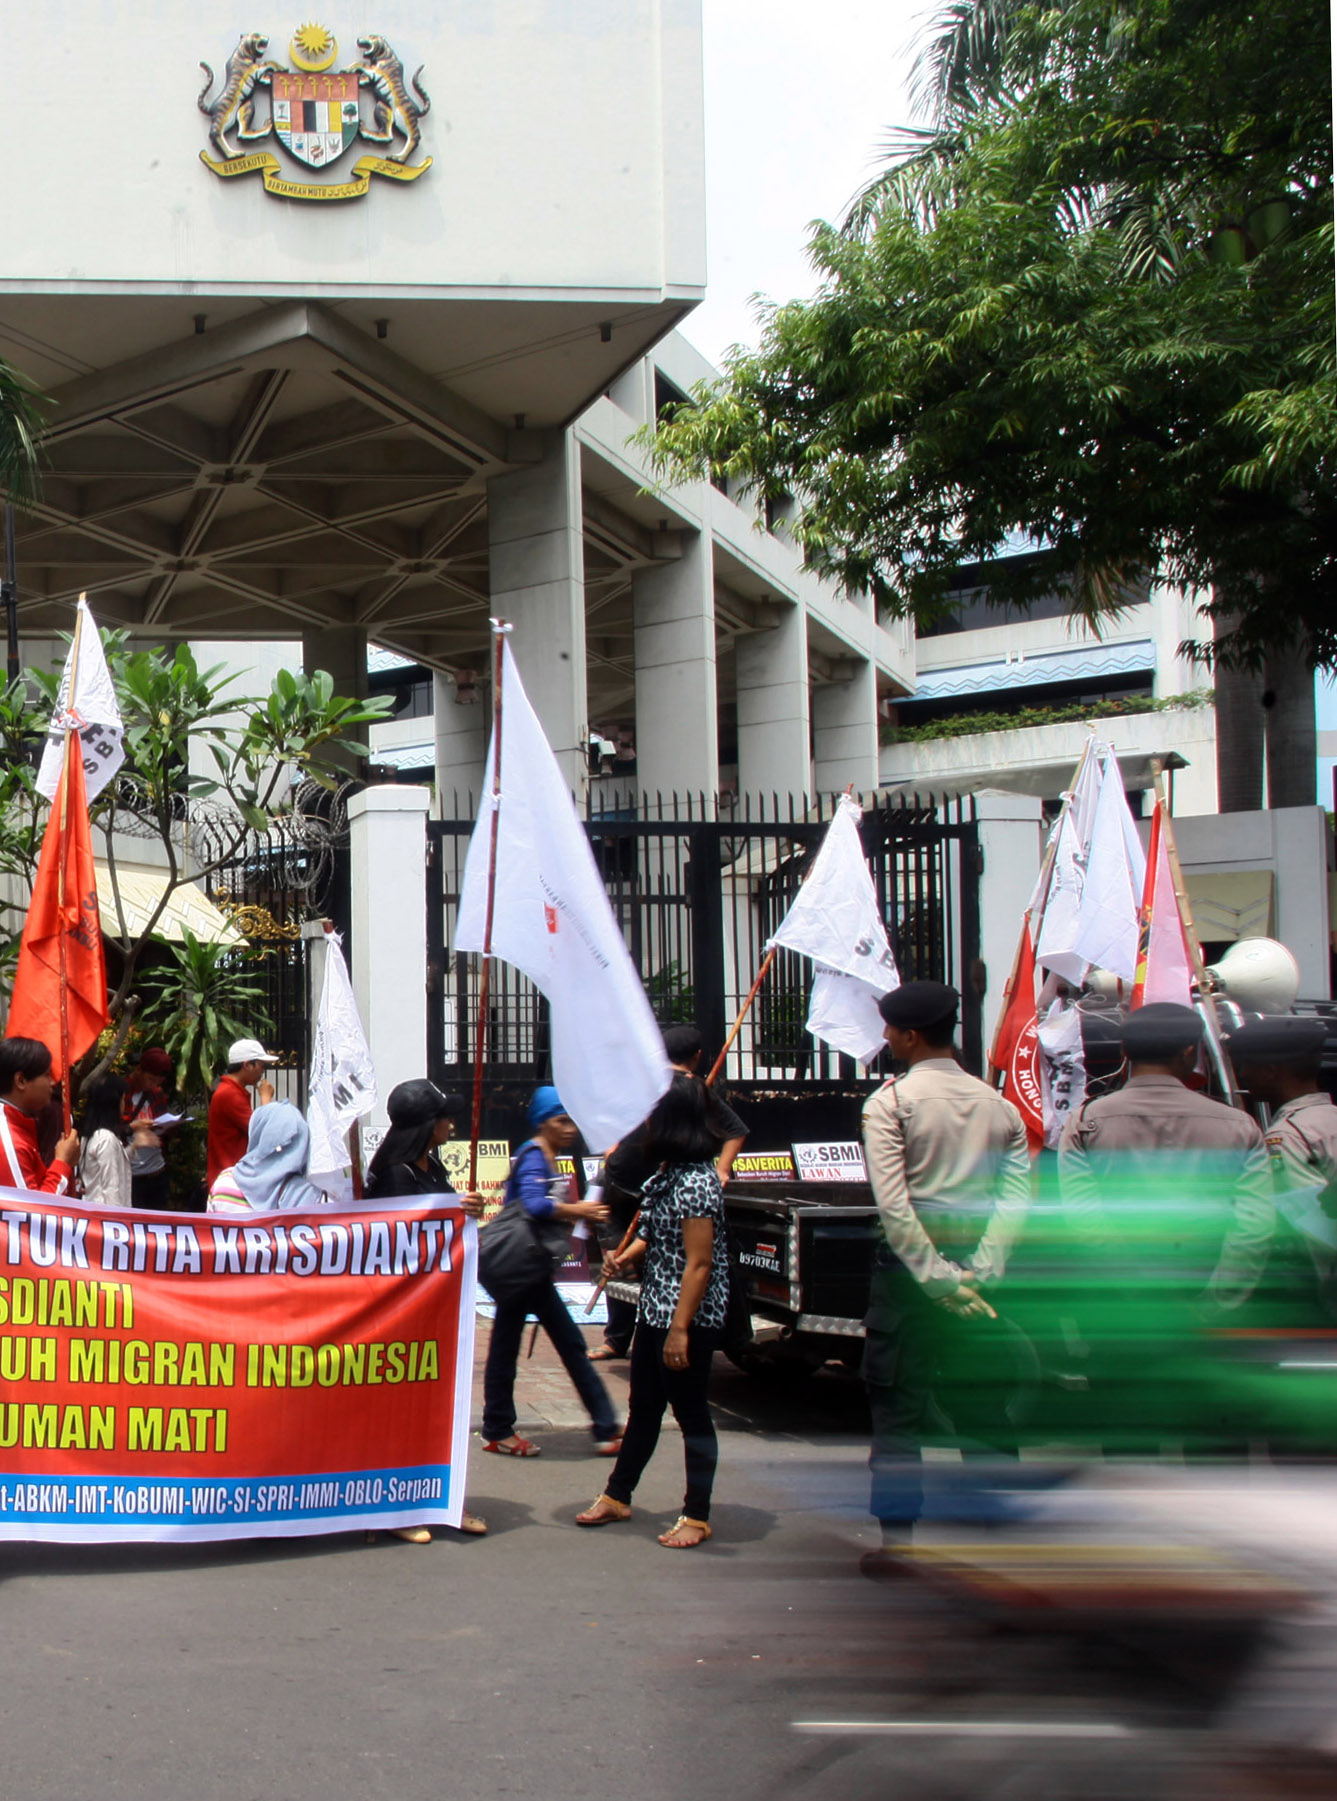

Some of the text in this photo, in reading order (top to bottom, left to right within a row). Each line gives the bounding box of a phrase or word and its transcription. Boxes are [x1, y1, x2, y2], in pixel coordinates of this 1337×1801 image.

[468, 1143, 507, 1156] BMI
[818, 1145, 861, 1162] SBMI
[801, 1168, 841, 1178] LAWAN
[101, 1220, 202, 1274] RITA
[213, 1218, 454, 1276] KRISDIANTI
[69, 1338, 235, 1388] MIGRAN
[246, 1339, 440, 1388] INDONESIA
[126, 1407, 228, 1454] MATI
